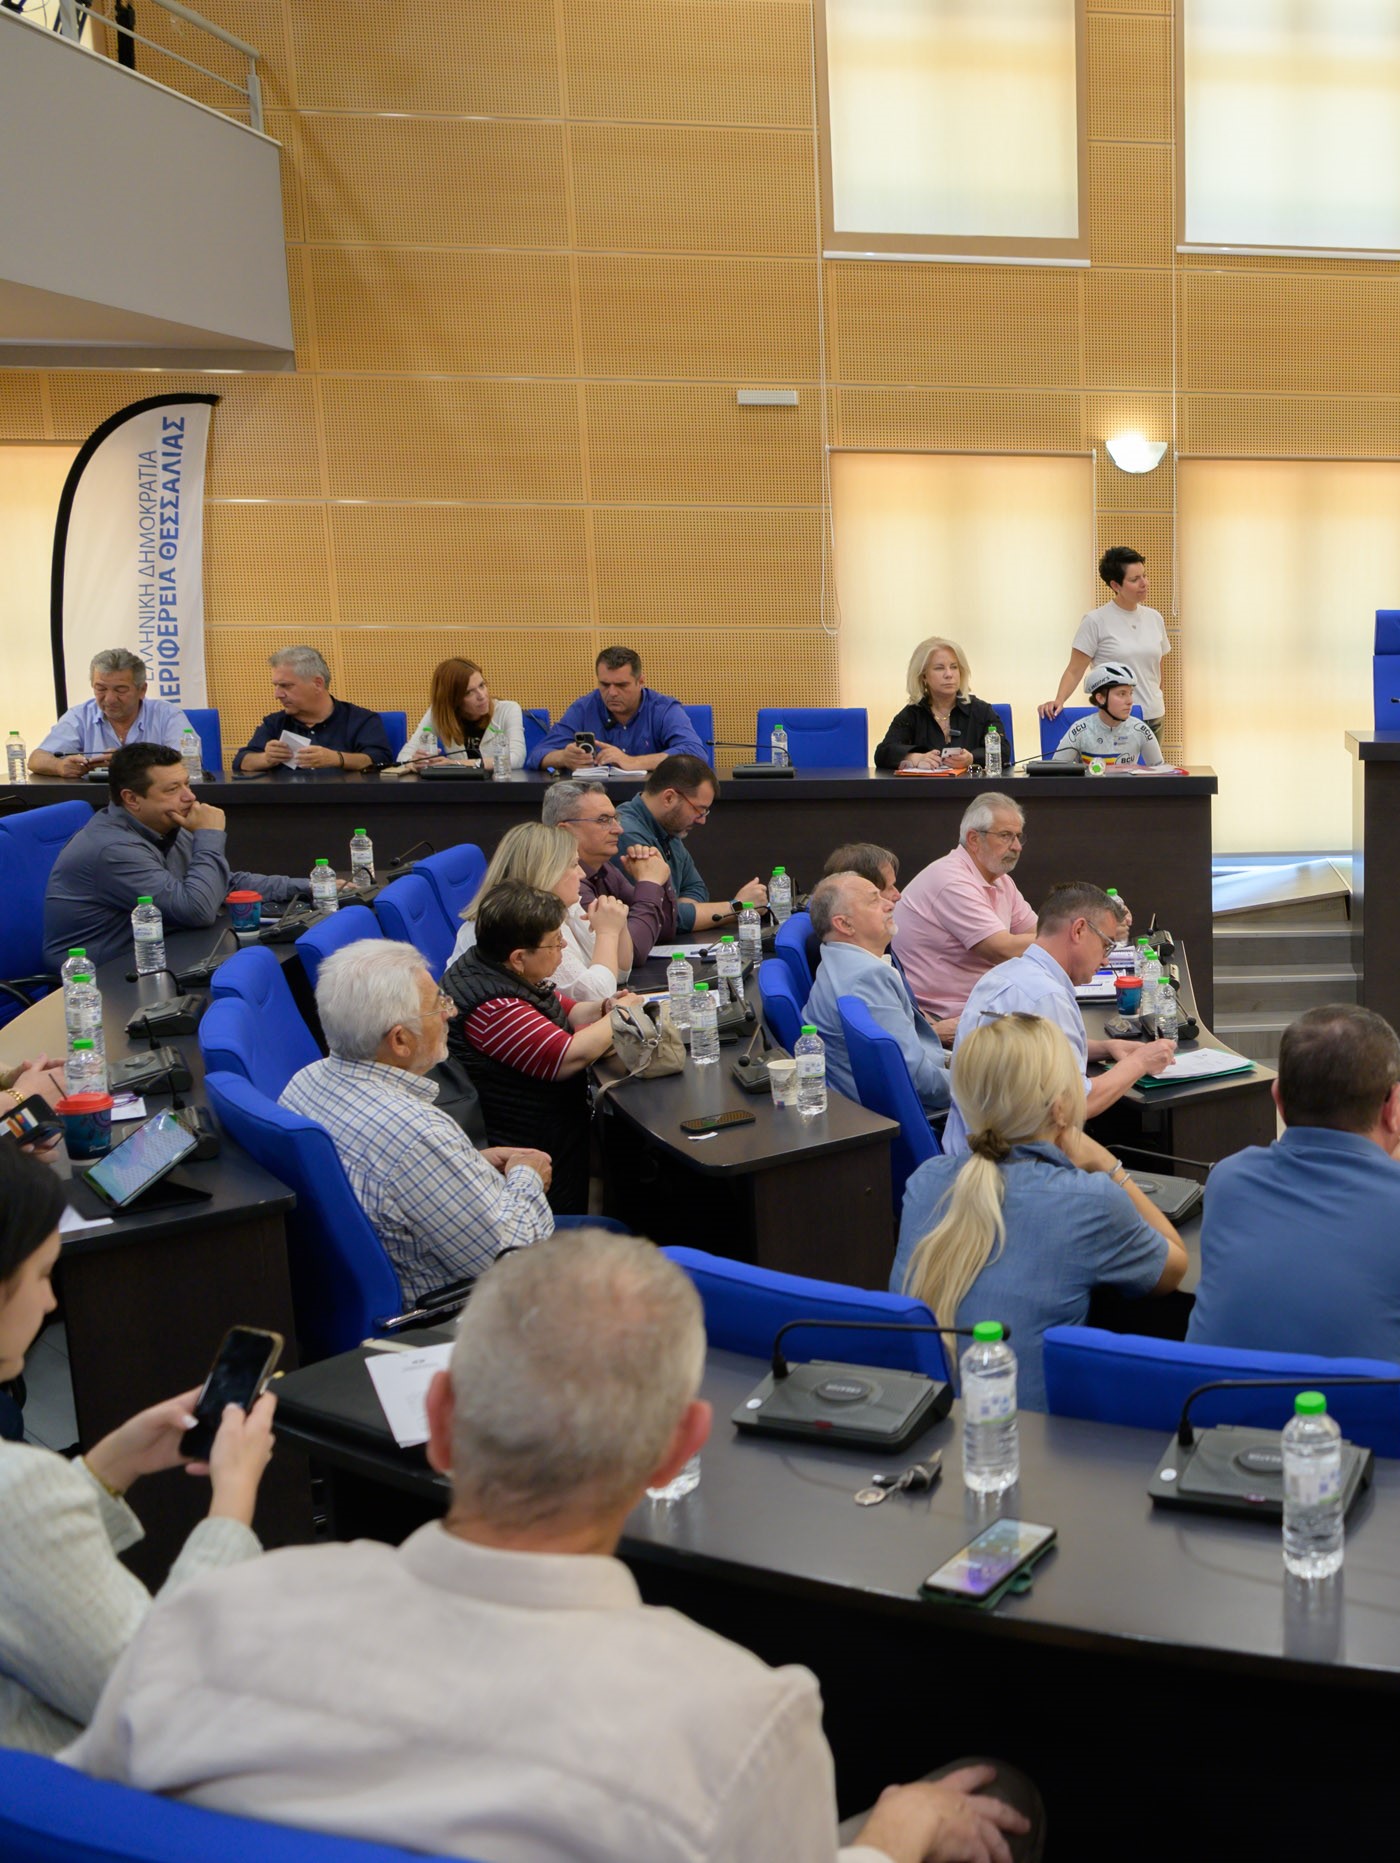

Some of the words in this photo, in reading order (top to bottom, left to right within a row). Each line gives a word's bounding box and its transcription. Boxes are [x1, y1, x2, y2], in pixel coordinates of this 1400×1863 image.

[158, 416, 185, 561] ΘΕΣΣΑΛΙΑΣ
[138, 450, 158, 578] ΔΗΜΟΚΡΑΤΙΑ
[1071, 723, 1087, 736] BCU
[1140, 725, 1153, 741] BCU
[1120, 755, 1135, 764] BCU
